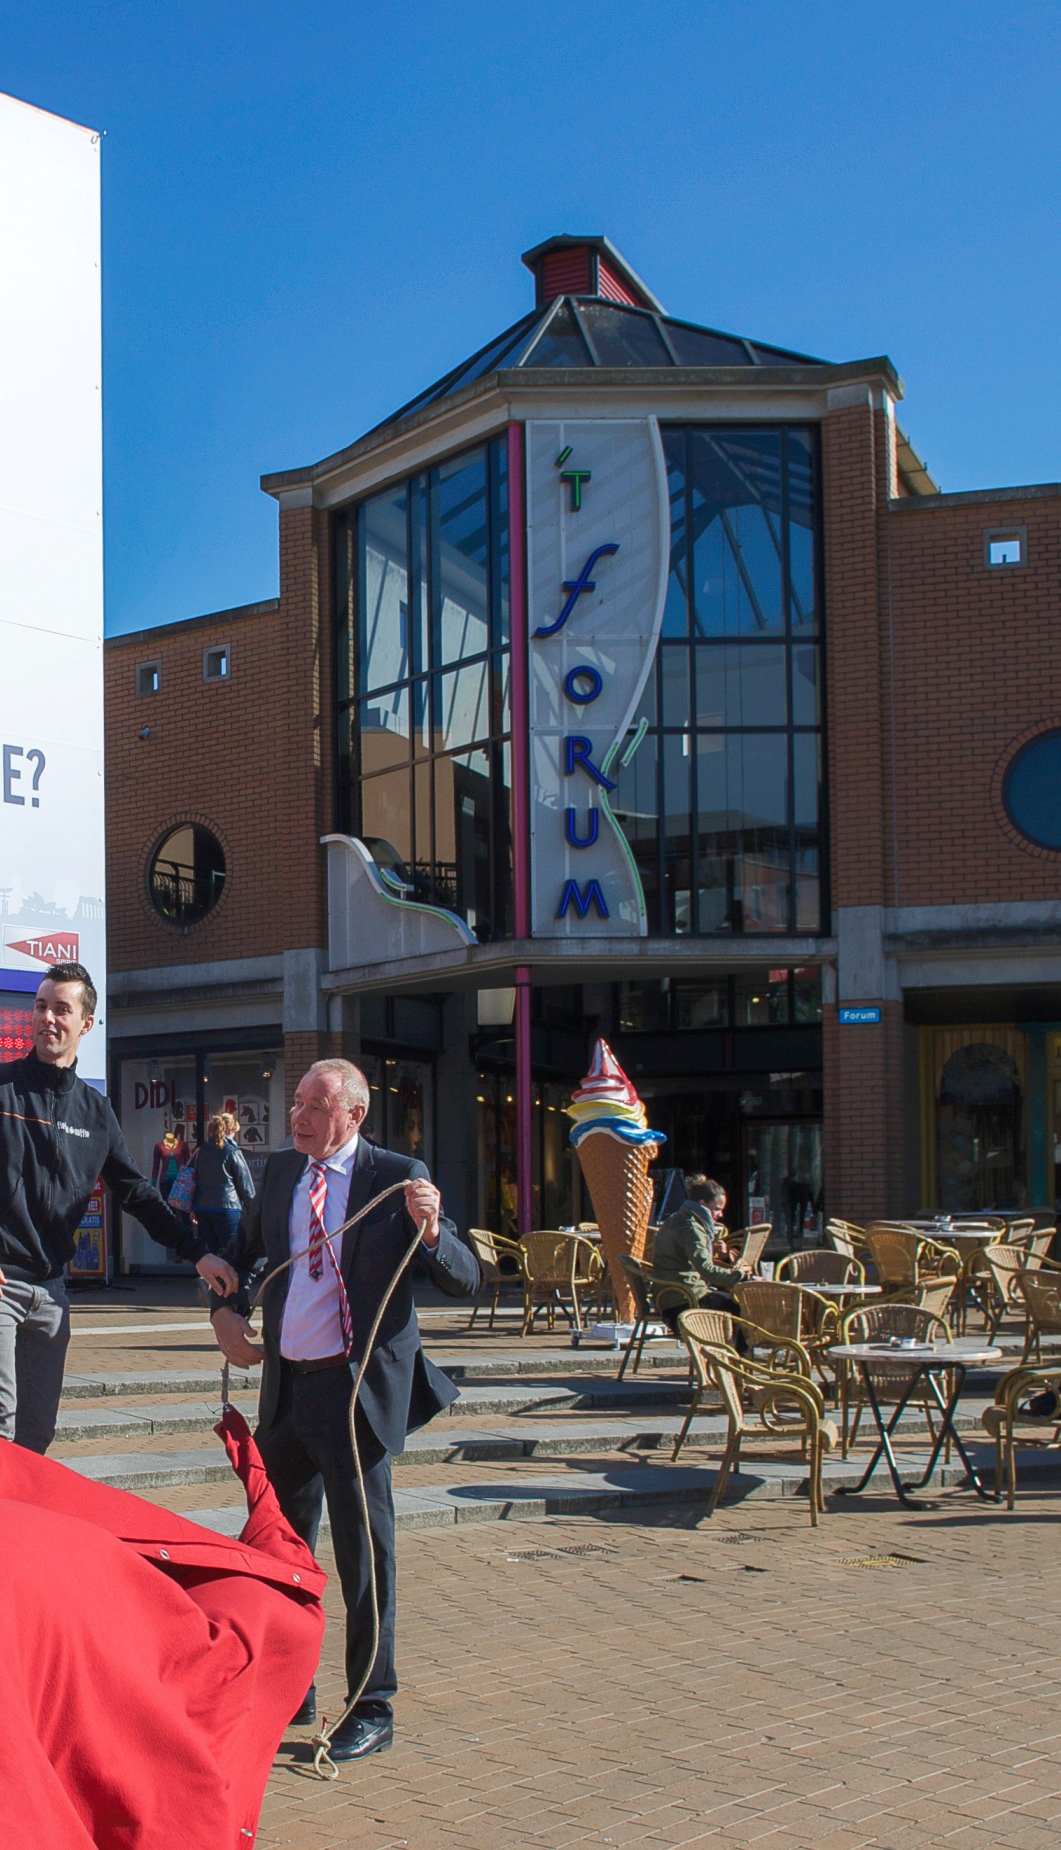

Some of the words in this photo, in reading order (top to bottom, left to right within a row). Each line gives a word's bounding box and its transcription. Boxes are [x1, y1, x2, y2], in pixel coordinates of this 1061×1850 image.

[26, 940, 77, 960] TIANI
[844, 1011, 876, 1020] Forum
[135, 1080, 176, 1110] DIDI
